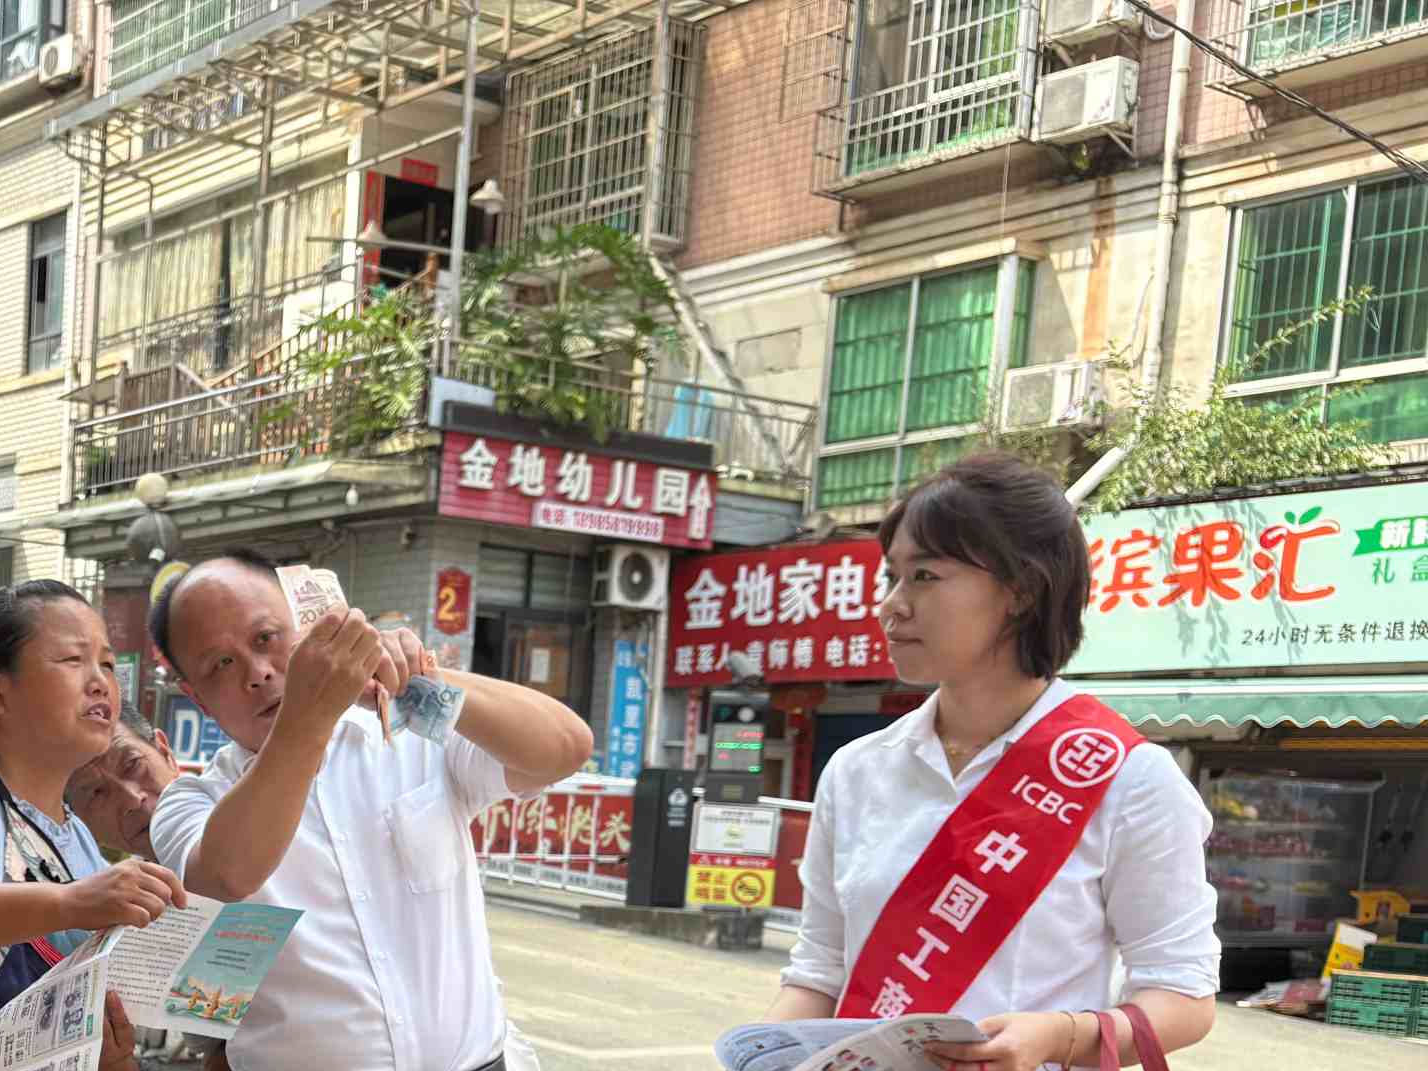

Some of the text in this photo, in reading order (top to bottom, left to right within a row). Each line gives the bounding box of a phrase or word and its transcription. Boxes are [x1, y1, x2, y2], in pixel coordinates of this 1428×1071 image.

[458, 437, 691, 517] 金地幼儿园
[438, 586, 460, 621] 2
[1011, 775, 1084, 825] ICBC
